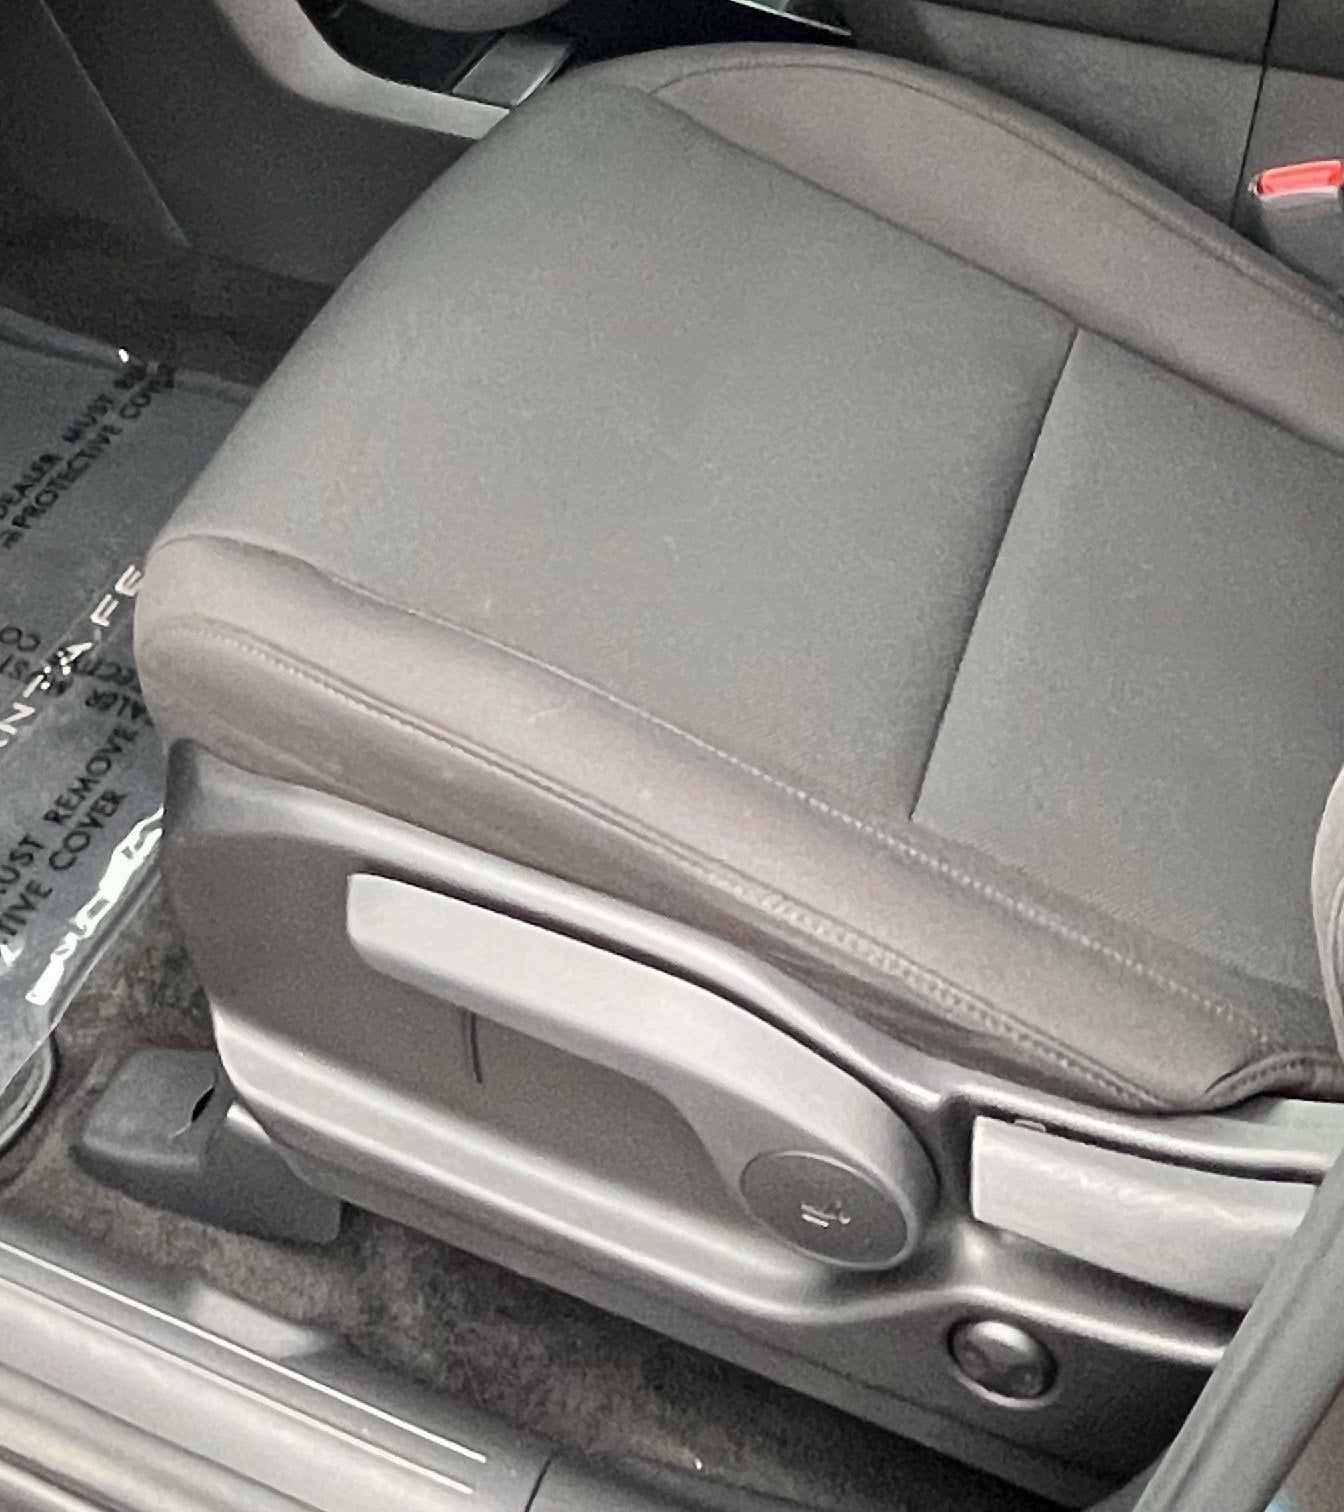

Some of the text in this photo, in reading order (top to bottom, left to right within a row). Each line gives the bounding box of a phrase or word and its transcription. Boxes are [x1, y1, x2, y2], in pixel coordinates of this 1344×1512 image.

[90, 564, 142, 628] FE
[43, 725, 139, 827] REMOVE
[49, 789, 129, 873] COVER
